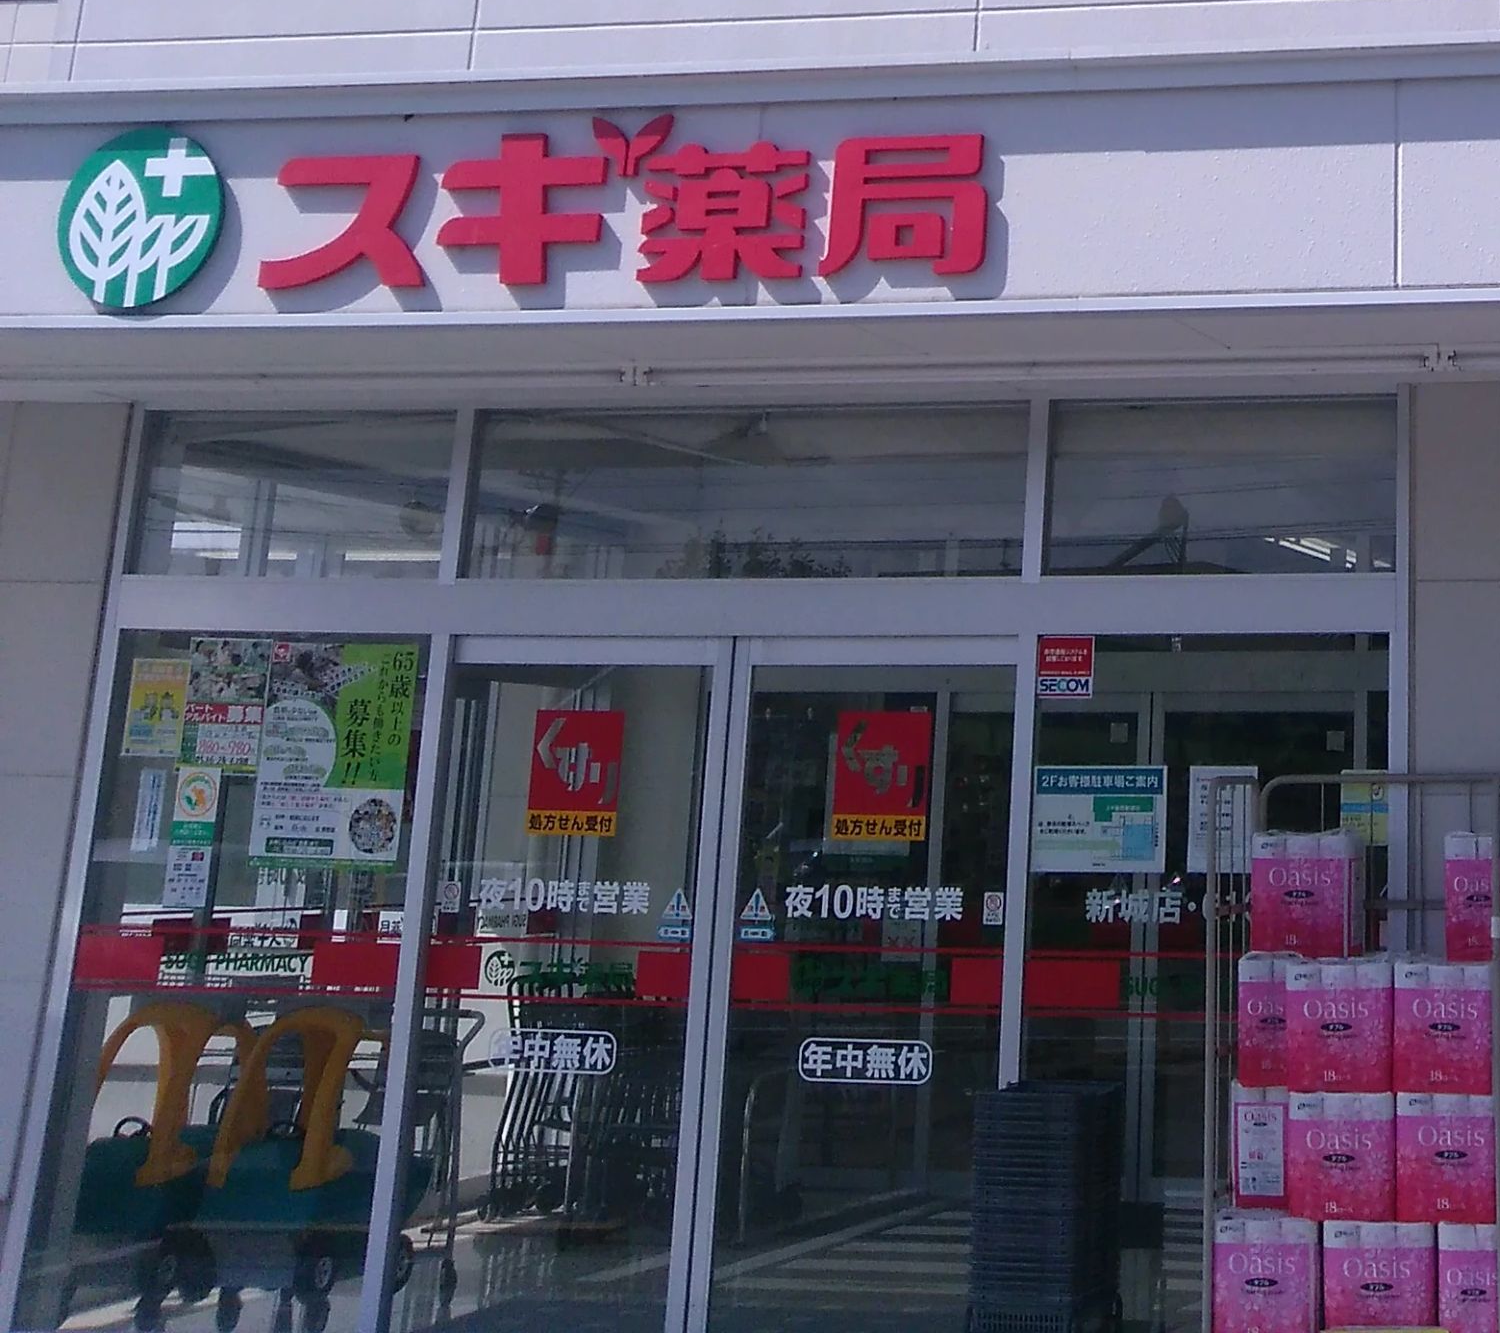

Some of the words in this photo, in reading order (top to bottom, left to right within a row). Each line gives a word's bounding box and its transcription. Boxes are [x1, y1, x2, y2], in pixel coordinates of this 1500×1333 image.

[256, 113, 987, 291] スギ薬局
[1040, 678, 1090, 693] SECOM
[537, 717, 618, 806] くすり
[841, 719, 926, 808] くすり
[528, 814, 614, 833] 処方せん受付
[834, 818, 922, 837] 処方せん受付
[1268, 866, 1331, 887] Oasis
[1303, 996, 1369, 1020] Oasis
[1412, 997, 1478, 1020] Oasis
[803, 1043, 929, 1079] 年中無休
[1305, 1128, 1372, 1151] Oasis
[1417, 1125, 1485, 1148] Oasis
[1228, 1252, 1296, 1276] Oasis
[1342, 1256, 1410, 1280] Oasis
